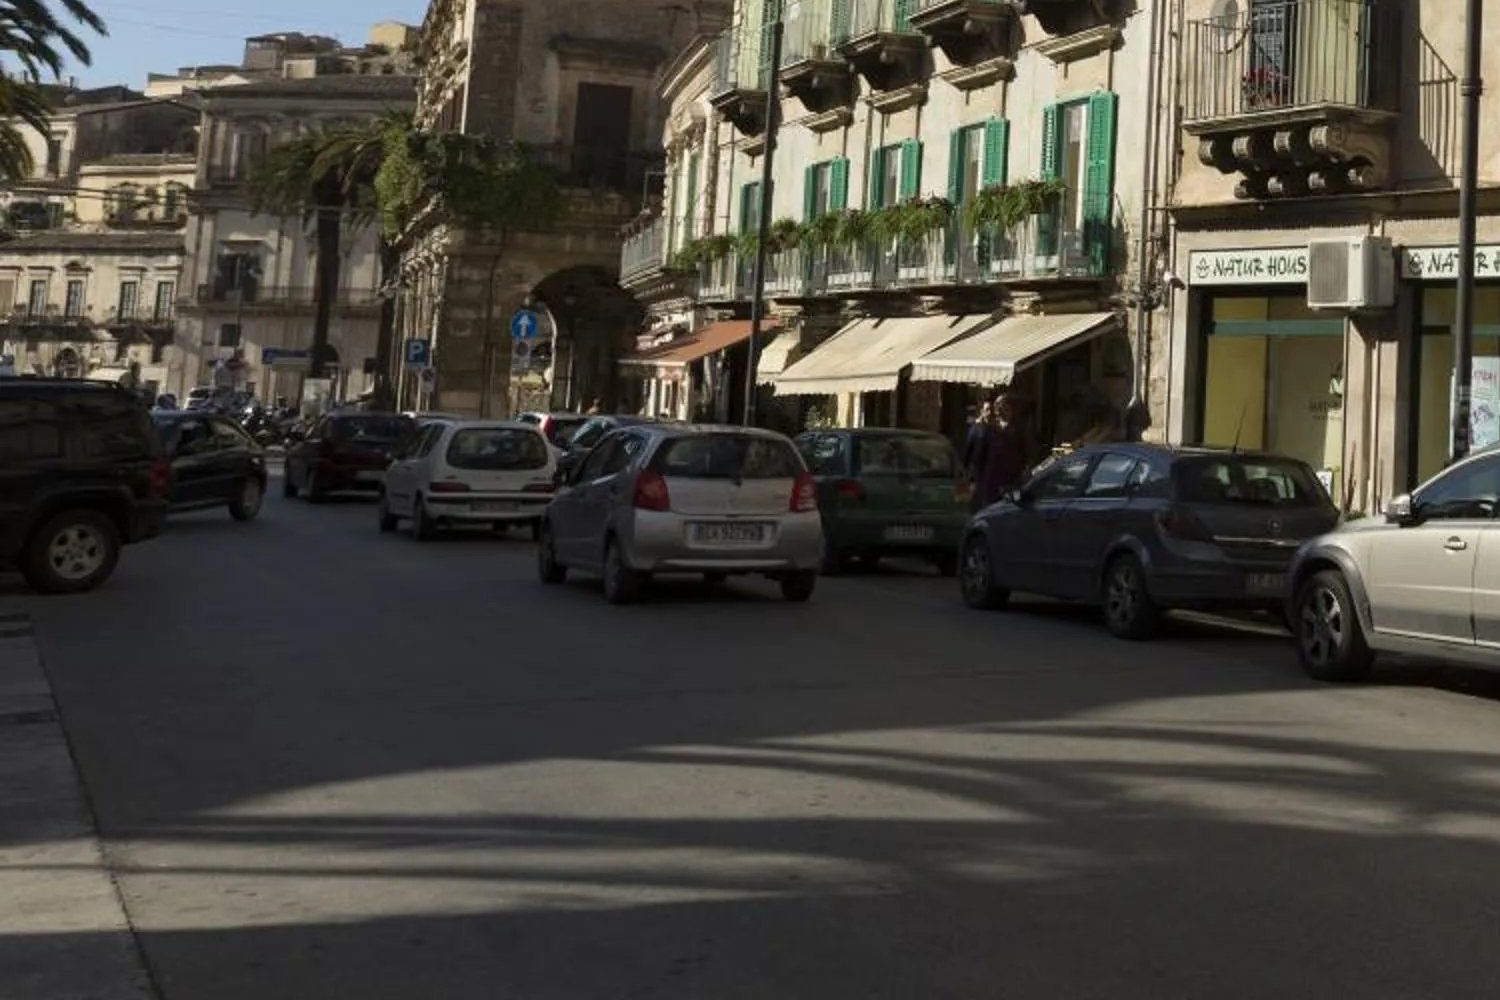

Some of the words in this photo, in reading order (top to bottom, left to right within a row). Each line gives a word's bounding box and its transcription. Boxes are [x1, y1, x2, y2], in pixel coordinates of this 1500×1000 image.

[1213, 256, 1264, 277] NATUR
[1267, 255, 1307, 276] HOUS
[1427, 251, 1489, 274] NAR
[409, 341, 423, 361] P
